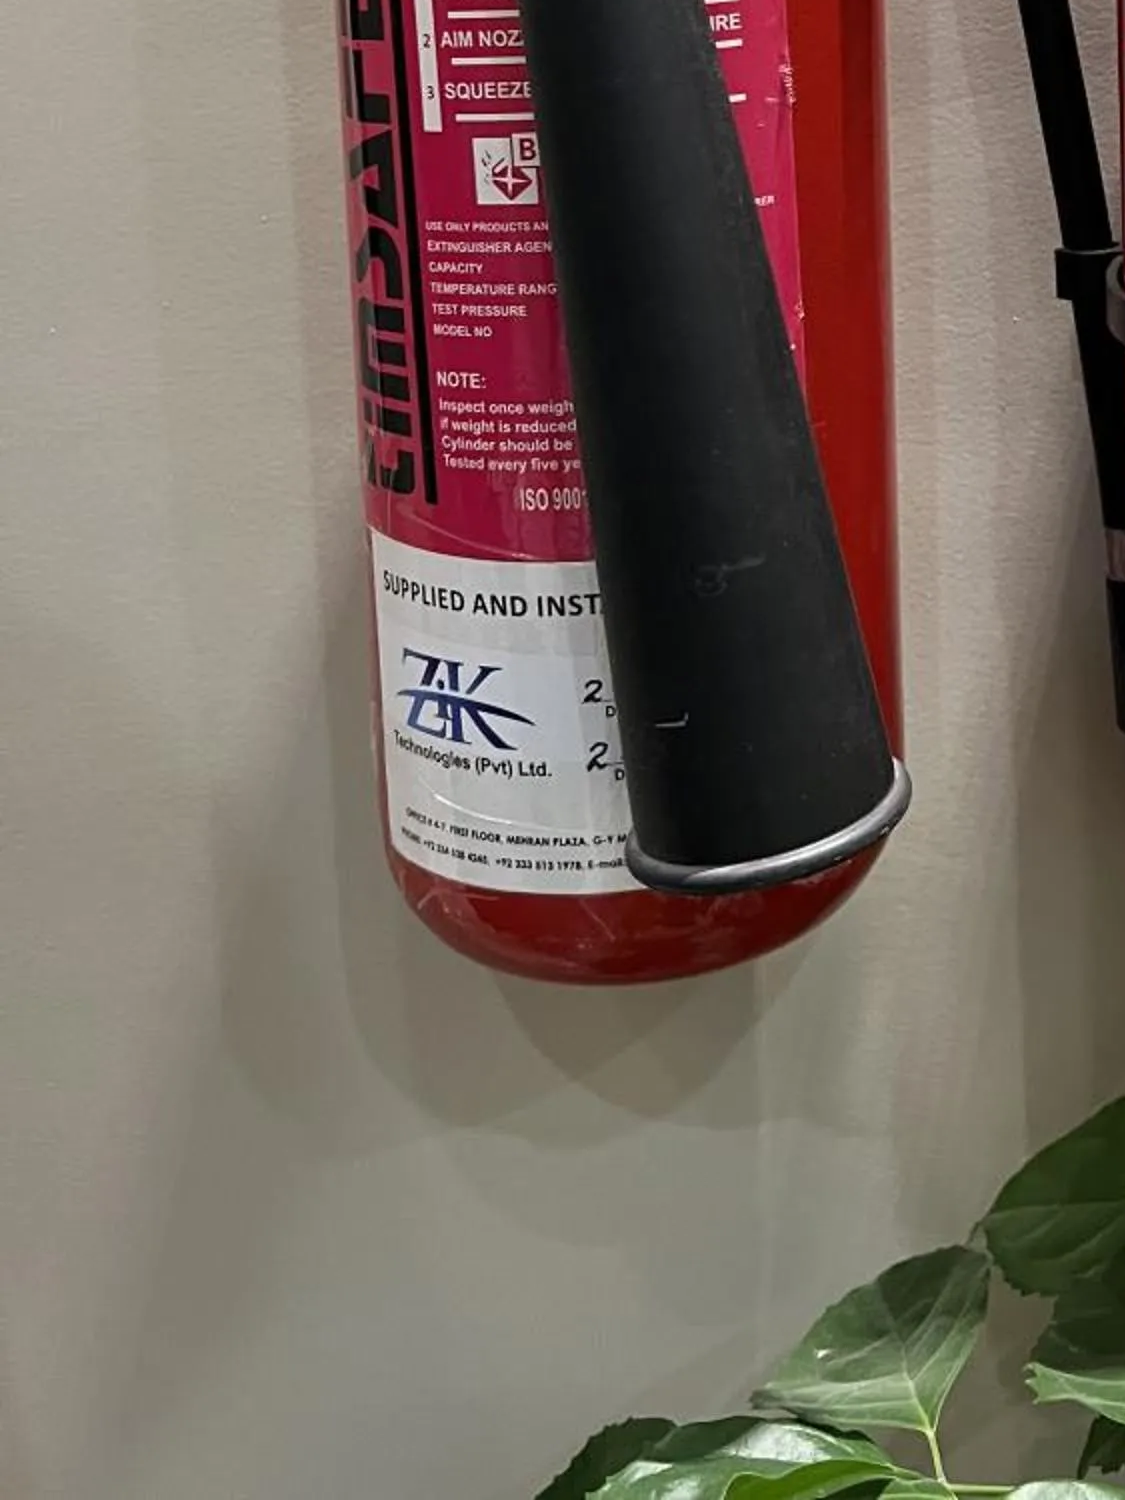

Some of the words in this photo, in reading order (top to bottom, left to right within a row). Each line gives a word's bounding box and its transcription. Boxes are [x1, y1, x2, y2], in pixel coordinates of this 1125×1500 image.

[422, 34, 431, 48] 2
[440, 30, 473, 48] AIM
[427, 86, 436, 100] 3
[444, 81, 532, 100] SQUEEZE
[518, 138, 537, 161] B
[425, 221, 442, 231] USE
[471, 222, 530, 233] PRODUCTS
[427, 240, 512, 253] EXTINGUISHER
[514, 242, 553, 253] AGEN
[428, 261, 483, 274] CAPACITY
[431, 281, 516, 295] TEMPERATURE
[518, 283, 558, 295] RANG
[432, 303, 458, 315] TEST
[461, 305, 528, 317] PRESSURE
[433, 324, 472, 337] MODEL
[437, 371, 487, 389] NOTE:
[439, 397, 486, 414] Inspect
[489, 402, 524, 414] once
[451, 420, 495, 435] weight
[498, 419, 511, 433] is
[515, 419, 577, 433] reduced
[441, 435, 495, 451] Cylinder
[499, 438, 549, 451] should
[553, 439, 573, 450] be
[443, 454, 484, 470] Tested
[487, 458, 527, 474] every
[531, 457, 558, 471] five
[519, 487, 549, 511] ISO
[384, 570, 464, 613] SUPPLIED
[473, 594, 527, 617] AND
[393, 730, 471, 771] Technologies
[475, 757, 513, 780] (Pvt)
[519, 761, 553, 777] Ltd.
